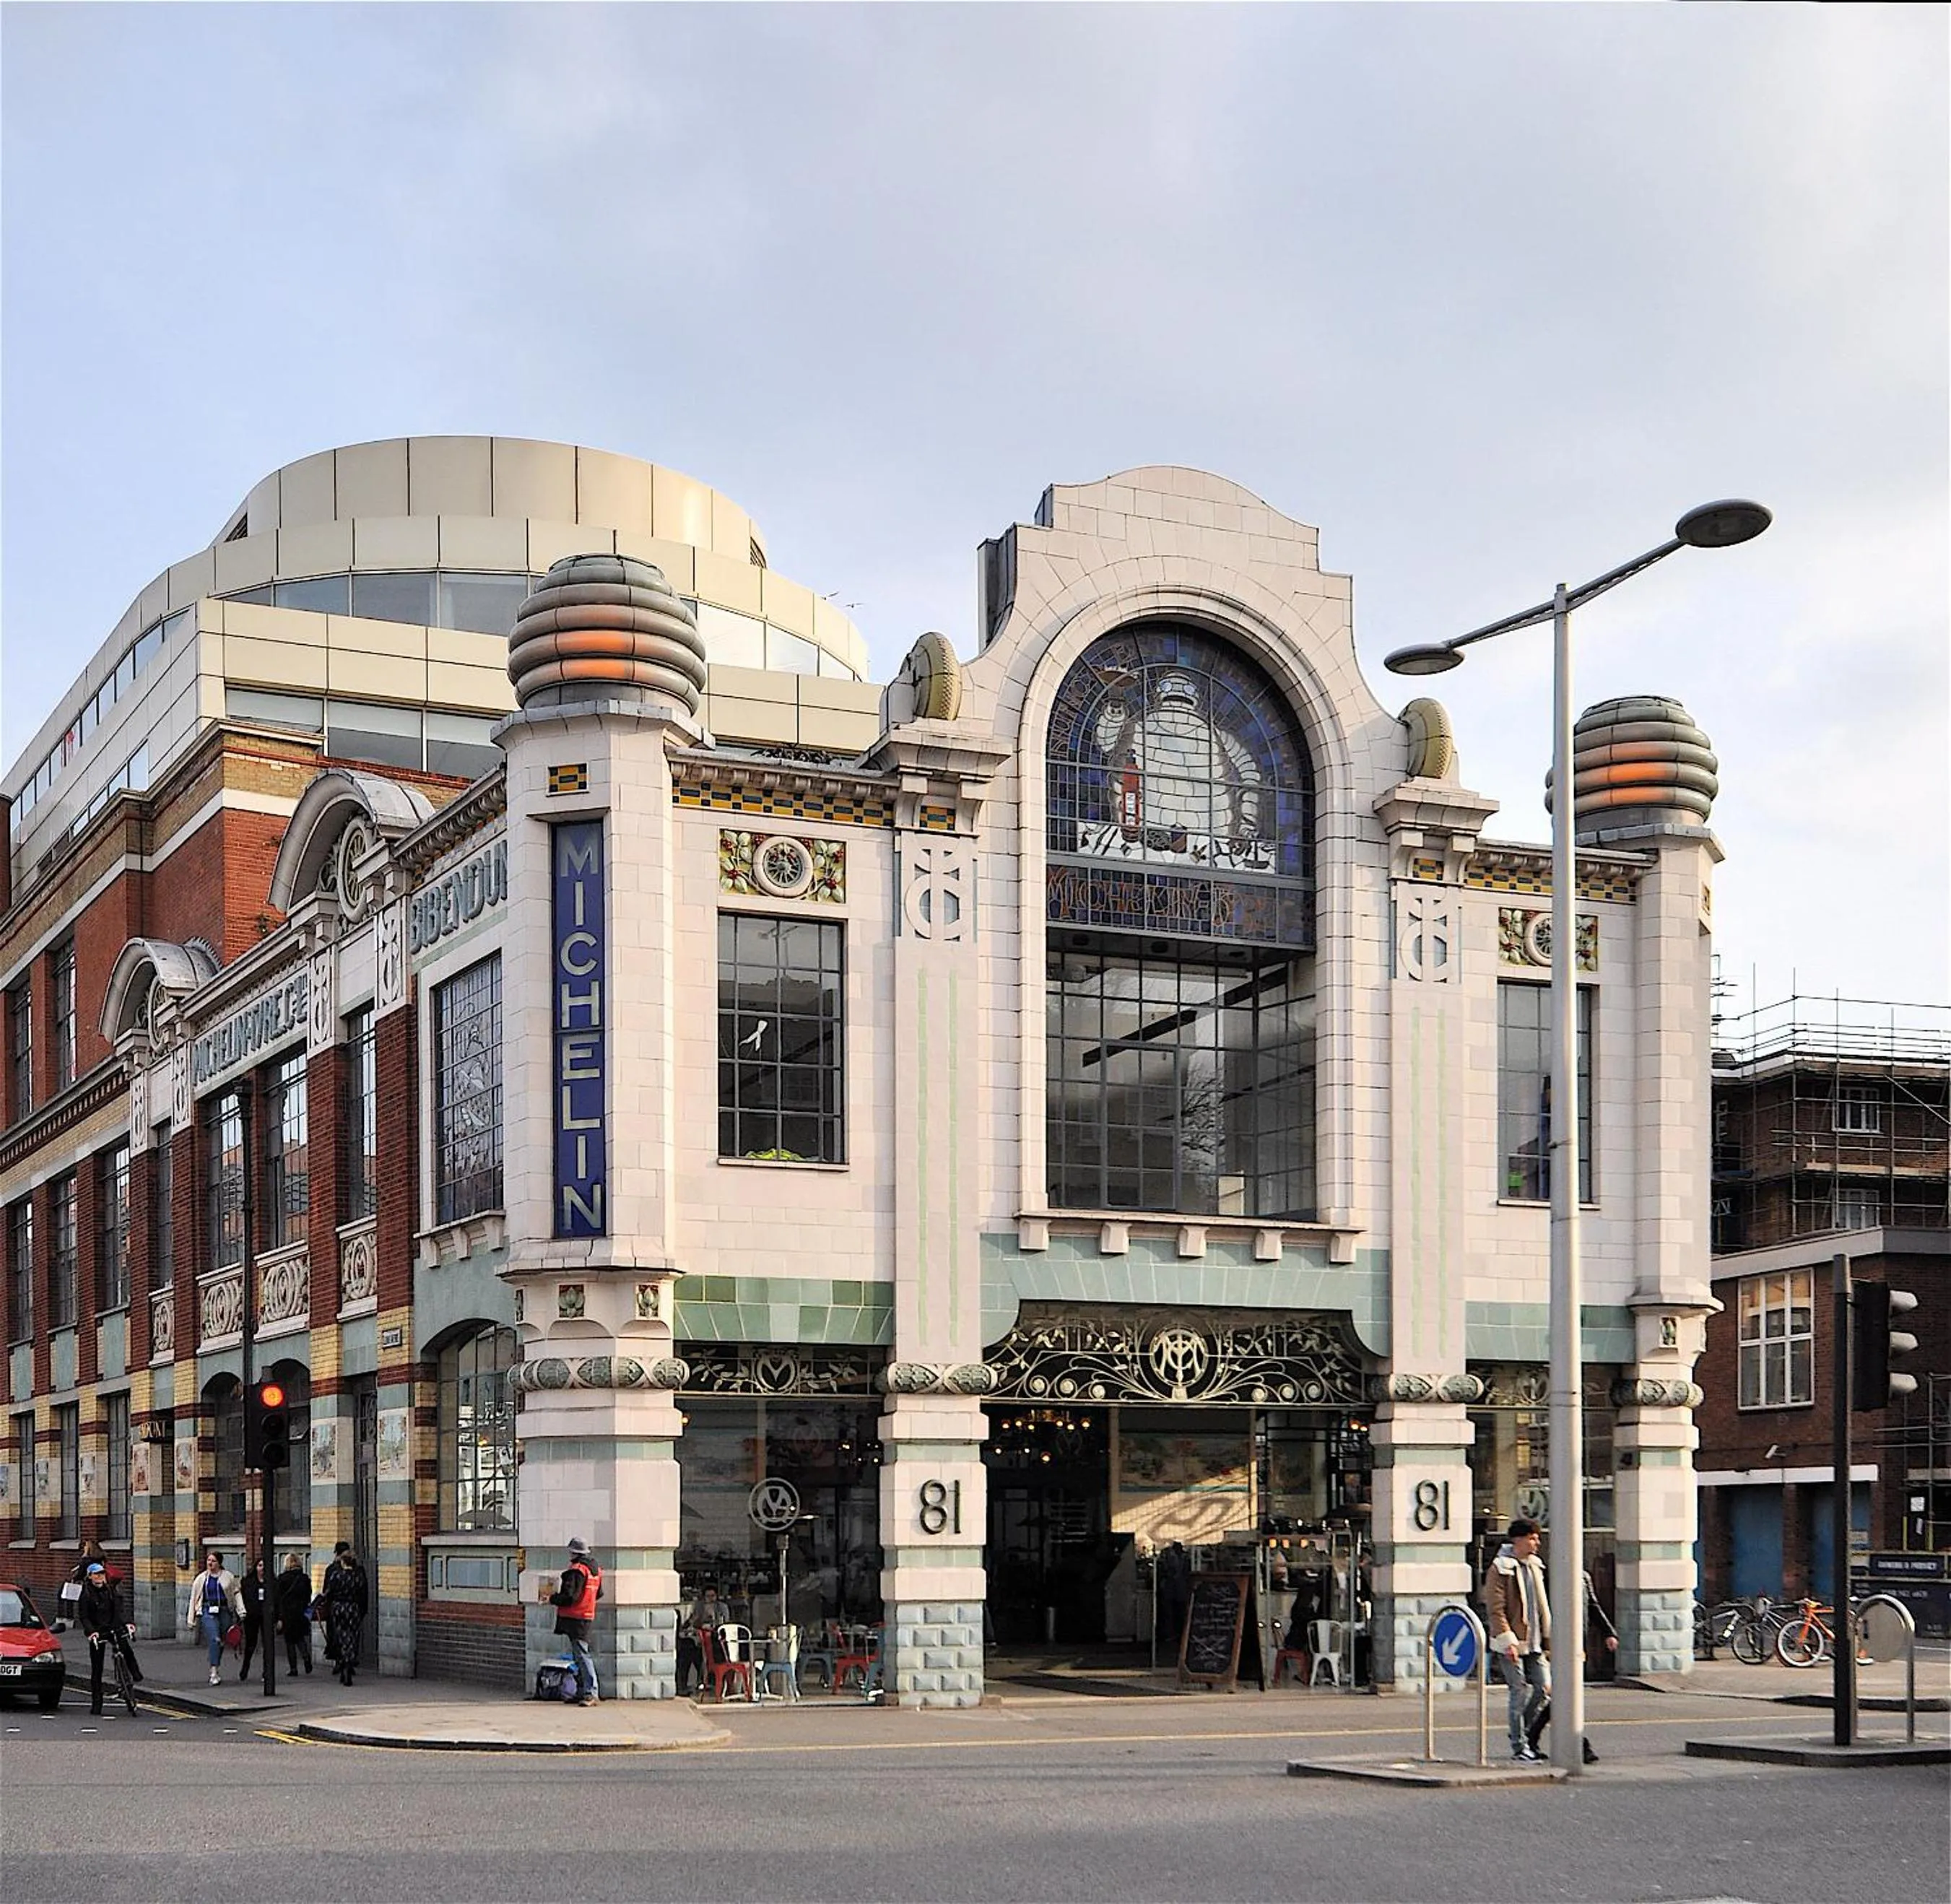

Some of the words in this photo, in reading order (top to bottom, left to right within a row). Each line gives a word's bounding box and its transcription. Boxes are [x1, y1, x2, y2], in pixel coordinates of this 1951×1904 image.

[560, 833, 602, 1231] MICHELIN
[918, 1478, 961, 1535] 81
[1414, 1479, 1449, 1531] 81
